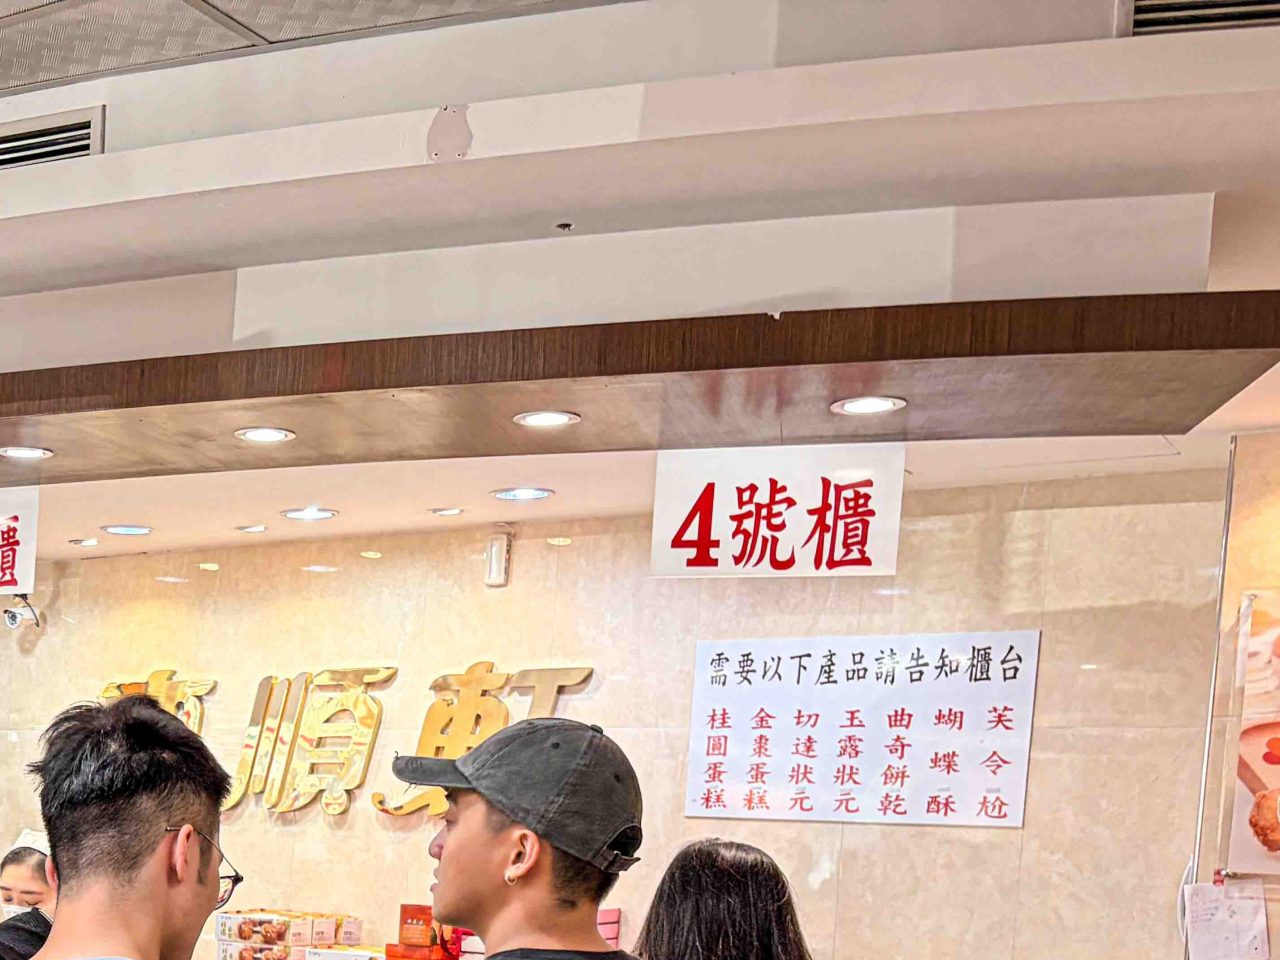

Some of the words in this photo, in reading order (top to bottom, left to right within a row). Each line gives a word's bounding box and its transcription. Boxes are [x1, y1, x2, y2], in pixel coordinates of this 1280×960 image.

[670, 476, 876, 571] 4號櫃
[709, 643, 1024, 687] 需要以下產品請告知櫃台
[98, 660, 595, 818] 順軒
[700, 707, 733, 810] 桂圓蛋糕
[788, 708, 821, 813] 切達狀元
[833, 708, 866, 814] 玉露狀元
[877, 707, 914, 816] 曲奇餅乾
[925, 707, 964, 817] 蝴蝶酥
[975, 705, 1016, 819] 芙令尬
